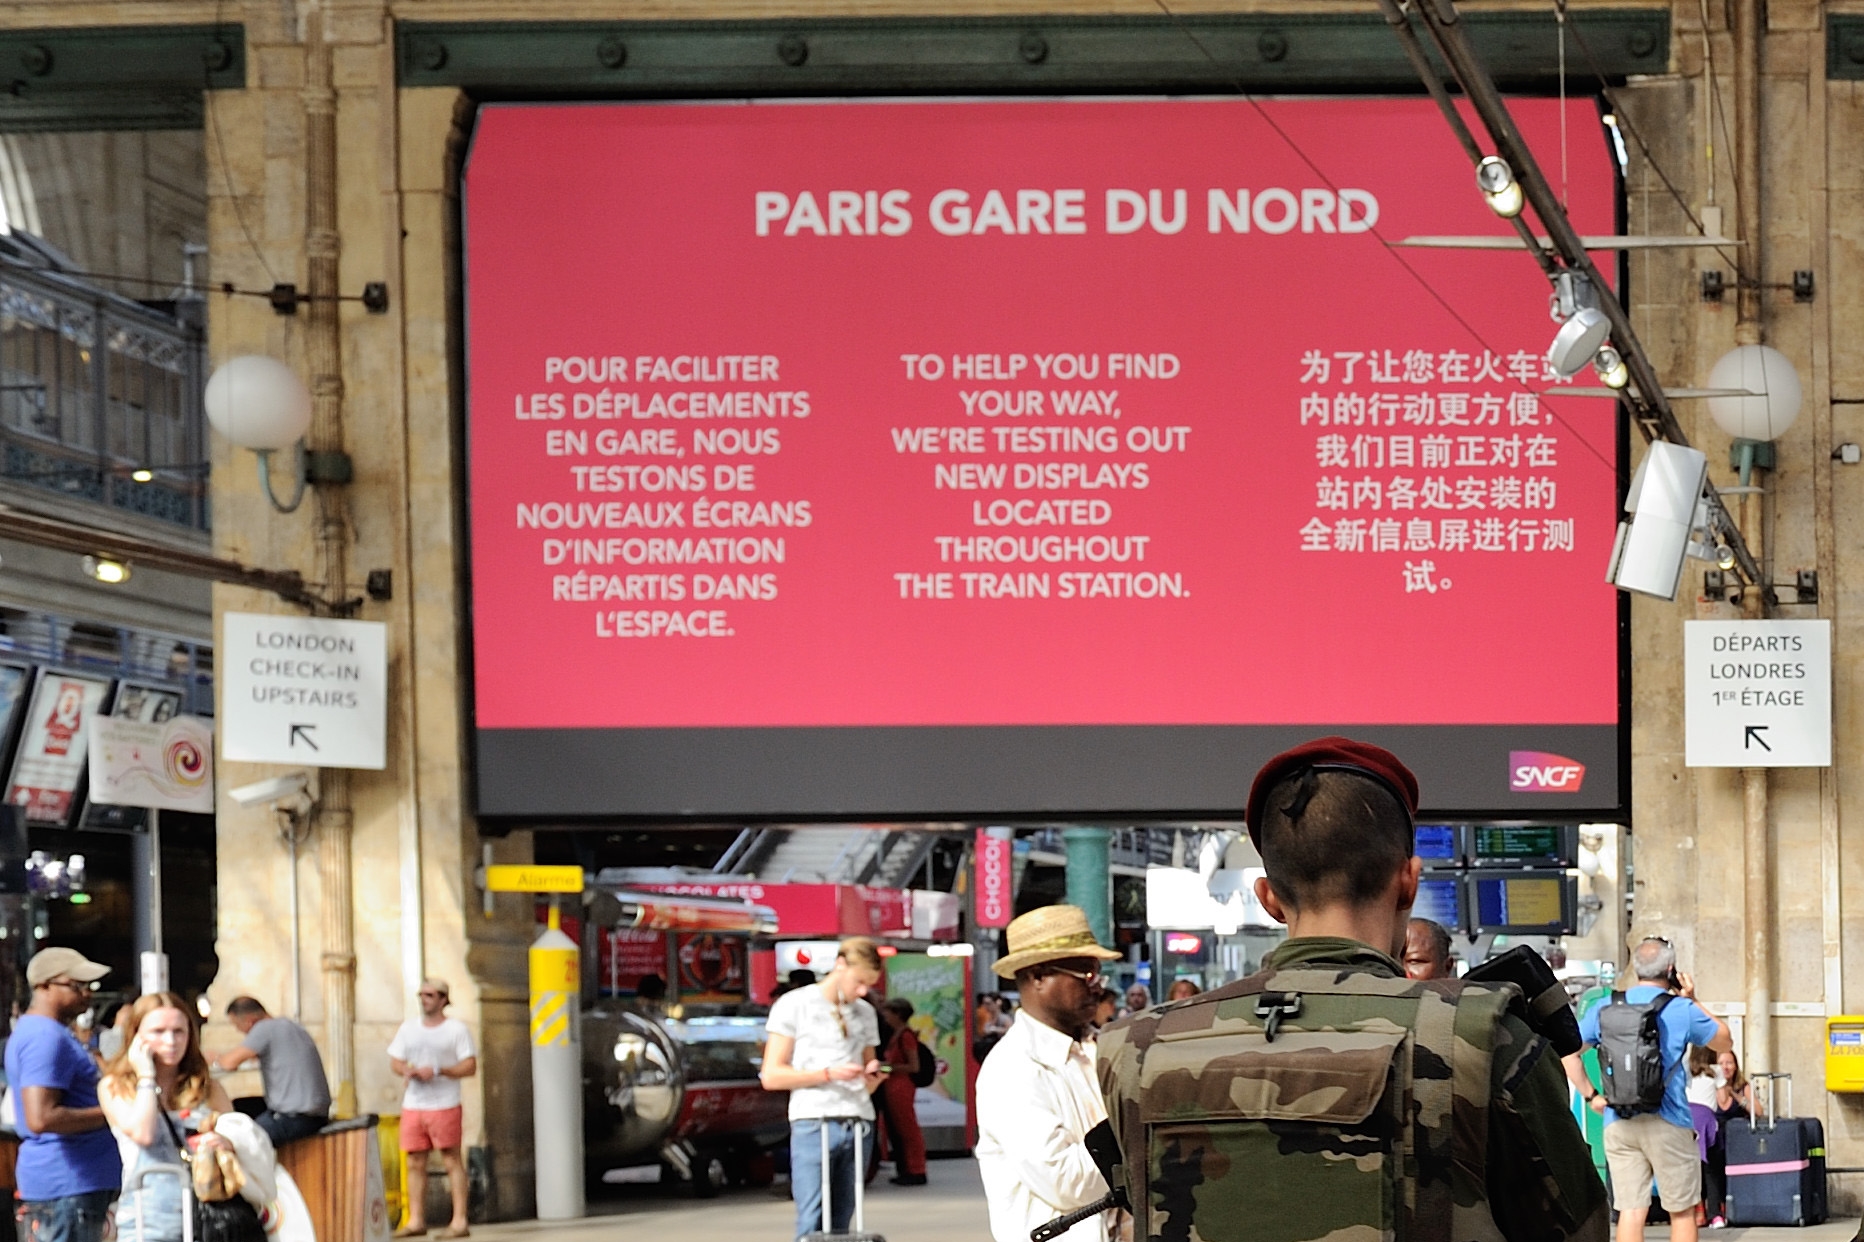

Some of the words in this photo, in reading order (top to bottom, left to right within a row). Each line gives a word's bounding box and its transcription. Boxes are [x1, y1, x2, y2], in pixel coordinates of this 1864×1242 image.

[754, 190, 912, 236] PARIS
[929, 189, 1087, 236] GARE
[1106, 189, 1187, 235] DU
[1208, 188, 1380, 234] NORD
[546, 357, 628, 383] POUR
[635, 356, 779, 382] FACILITER
[900, 354, 944, 381] TO
[952, 354, 1027, 380] HELP
[1033, 354, 1099, 380] YOU
[1108, 353, 1181, 379] FIND
[515, 394, 566, 420] LES
[573, 387, 811, 419] DÉPLACEMENTS
[959, 390, 1044, 417] YOUR
[1050, 390, 1121, 420] WAY,
[546, 430, 588, 456] EN
[595, 429, 685, 458] GARE,
[693, 428, 780, 455] NOUS
[891, 427, 986, 453] WE'RE
[992, 426, 1118, 453] TESTING
[1126, 426, 1191, 452] OUT
[1316, 434, 1558, 469] 我们目前正对在
[570, 465, 707, 492] TESTONS
[713, 465, 755, 491] DE
[935, 463, 1007, 489] NEW
[1014, 463, 1150, 489] DISPLAYS
[1316, 476, 1556, 511] 站内各处安装的
[516, 502, 685, 529] NOUVEAUX
[692, 496, 812, 528] ÉCRANS
[973, 499, 1111, 526] LOCATED
[934, 535, 1150, 562] THROUGHOUT
[1300, 518, 1574, 552] 全新信息屏进行测
[543, 537, 785, 565] D'INFORMATION
[552, 570, 686, 601] RÉPARTIS
[693, 573, 778, 600] DANS
[894, 573, 954, 599] THE
[960, 572, 1050, 598] TRAIN
[1058, 572, 1191, 598] STATION.
[1402, 560, 1452, 593] 试。
[596, 610, 735, 637] L'ESPACE.
[256, 631, 354, 652] LONDON
[1713, 632, 1803, 652] DÉPARTS
[250, 658, 359, 681] CHECK-IN
[1710, 663, 1806, 679] LONDRES
[252, 686, 358, 709] UPSTAIRS
[1741, 687, 1805, 706] ÉTAGE
[1512, 766, 1581, 787] SNCF
[517, 872, 576, 887] Alarme
